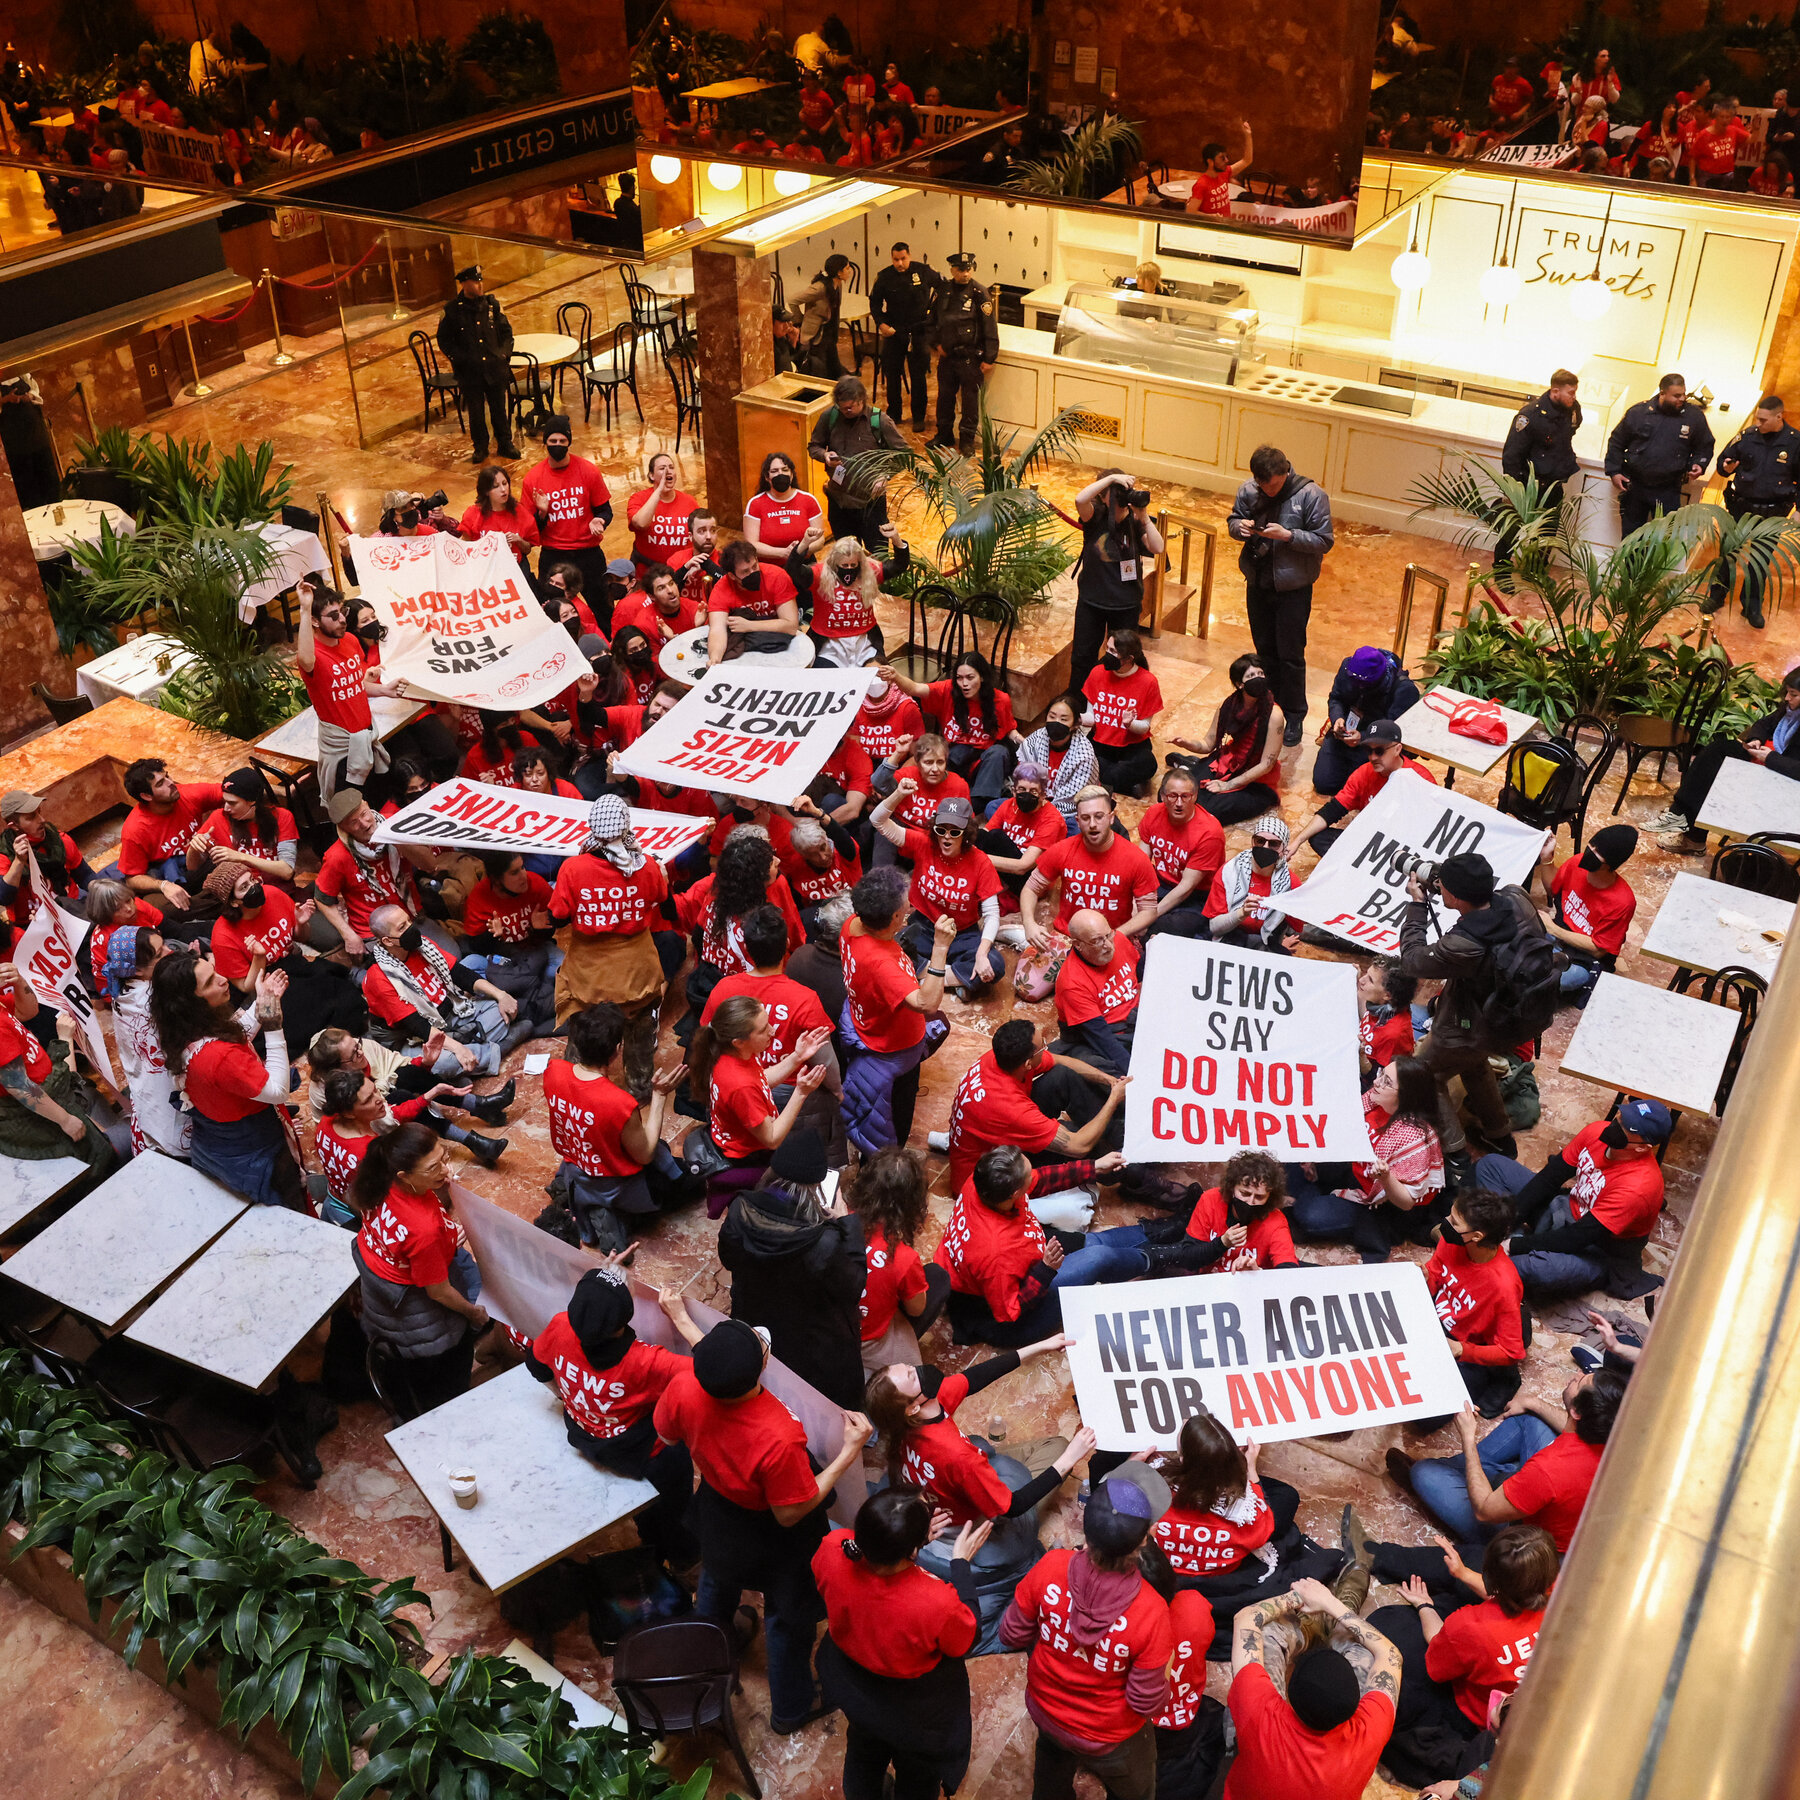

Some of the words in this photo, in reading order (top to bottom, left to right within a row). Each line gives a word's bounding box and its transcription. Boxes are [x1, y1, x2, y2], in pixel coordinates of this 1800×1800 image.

[1543, 228, 1655, 259] TRUMP
[1525, 252, 1657, 299] Swets
[570, 486, 584, 497] IN
[548, 507, 584, 523] NAME
[551, 497, 579, 511] OUR
[767, 509, 801, 518] PALESTINE
[653, 525, 685, 536] OUR
[833, 602, 864, 612] STO
[432, 635, 497, 656] FOR
[704, 683, 856, 718] STUDENTS
[1097, 691, 1137, 708] STOP
[705, 712, 816, 738] NOT
[682, 729, 800, 766] NAZIS
[860, 736, 897, 746] RMING
[862, 745, 895, 756] RAEL
[658, 752, 770, 783] FIGHT
[912, 794, 936, 807] NOT
[430, 783, 591, 848] ALESTINE
[161, 830, 185, 852] NOT
[1423, 808, 1486, 858] NO
[1149, 835, 1173, 850] NOT
[1175, 847, 1188, 860] IN
[801, 878, 826, 891] NOT
[829, 869, 842, 881] IN
[919, 874, 970, 901] ARMING
[928, 865, 968, 889] STOP
[1064, 868, 1097, 882] NOT
[1104, 874, 1120, 885] IN
[580, 886, 638, 900] STOP
[1065, 892, 1119, 911] NAME
[1070, 883, 1110, 897] OUR
[577, 899, 645, 913] ARMING
[502, 912, 518, 925] OT
[577, 911, 644, 926] ISRAEL
[260, 918, 288, 947] TOP
[1119, 962, 1132, 978] IN
[1192, 957, 1294, 1016] JEWS
[1206, 1011, 1274, 1053] SAY
[1163, 1048, 1217, 1096] DO
[1237, 1057, 1318, 1107] NOT
[549, 1094, 595, 1125] JEWS
[554, 1112, 588, 1138] SAY
[1152, 1096, 1328, 1148] COMPLY
[316, 1129, 358, 1169] JEWS
[1458, 1288, 1476, 1310] IN
[1095, 1302, 1248, 1374] NEVER
[1263, 1290, 1407, 1363] AGAIN
[555, 1355, 625, 1398] JEWS
[560, 1376, 614, 1414] SAY
[1114, 1377, 1204, 1435] FOR
[1226, 1352, 1423, 1429] ANYONE
[1157, 1521, 1230, 1544] STOP
[1155, 1538, 1234, 1559] RMING
[1044, 1583, 1128, 1633] STP
[1040, 1622, 1126, 1673] SRAEL
